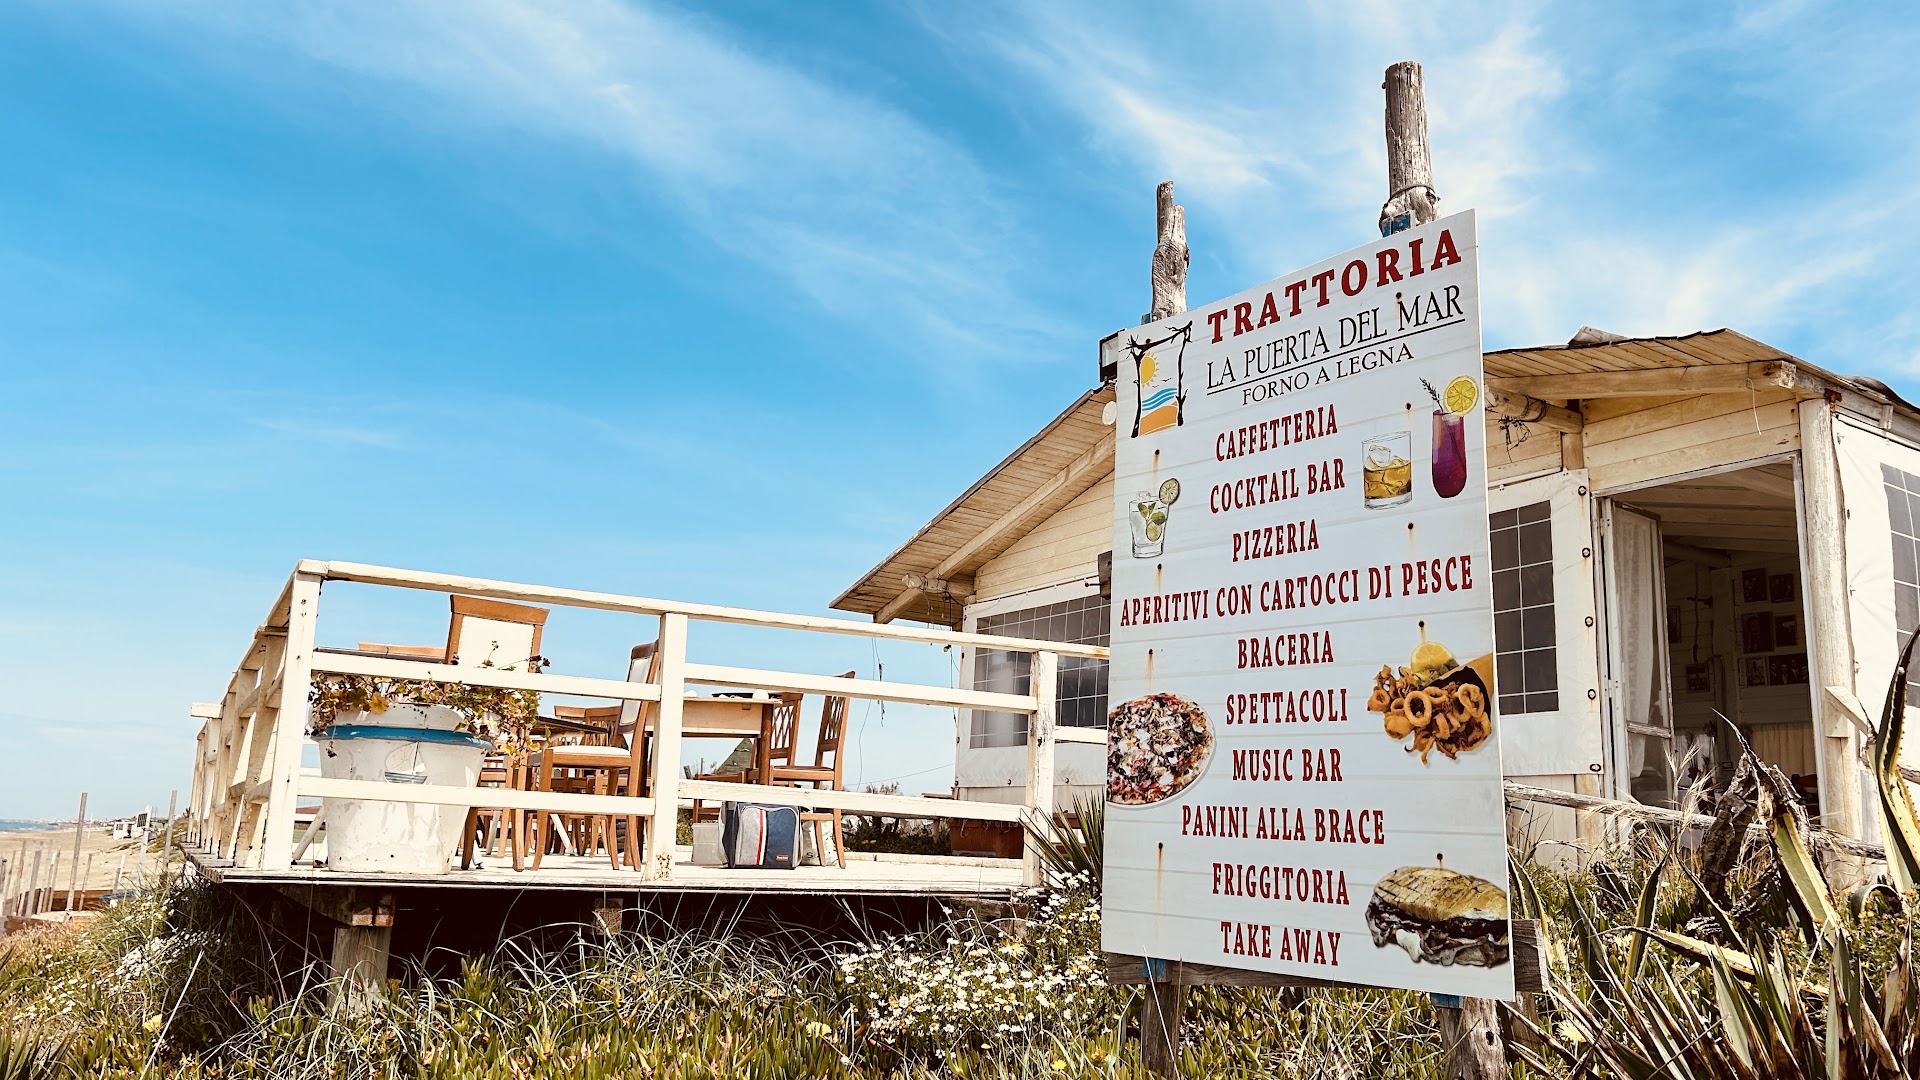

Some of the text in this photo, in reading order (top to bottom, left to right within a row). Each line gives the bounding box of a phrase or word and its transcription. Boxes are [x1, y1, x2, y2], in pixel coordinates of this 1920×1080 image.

[1207, 229, 1461, 344] TRATTORIA
[1207, 285, 1464, 389] LA PUERTA DEL MAR
[1242, 342, 1414, 406] FORNO A LEGNA
[1216, 404, 1338, 461] CAFFETTERIA
[1210, 458, 1345, 514] COCKTAIL BAR
[1232, 519, 1319, 562] PIZZERIA
[1121, 555, 1473, 626] APERITIVI CON CARTOCCI DI PESCE
[1238, 631, 1334, 669] BRACERIA
[1226, 689, 1347, 725] SPETTACOLI
[1232, 749, 1342, 782] MUSIC BAR
[1182, 805, 1385, 844] PANINI ALLA BRACE
[1212, 863, 1349, 905] FRIGGITORIA
[1221, 922, 1341, 966] TAKE AWAY
